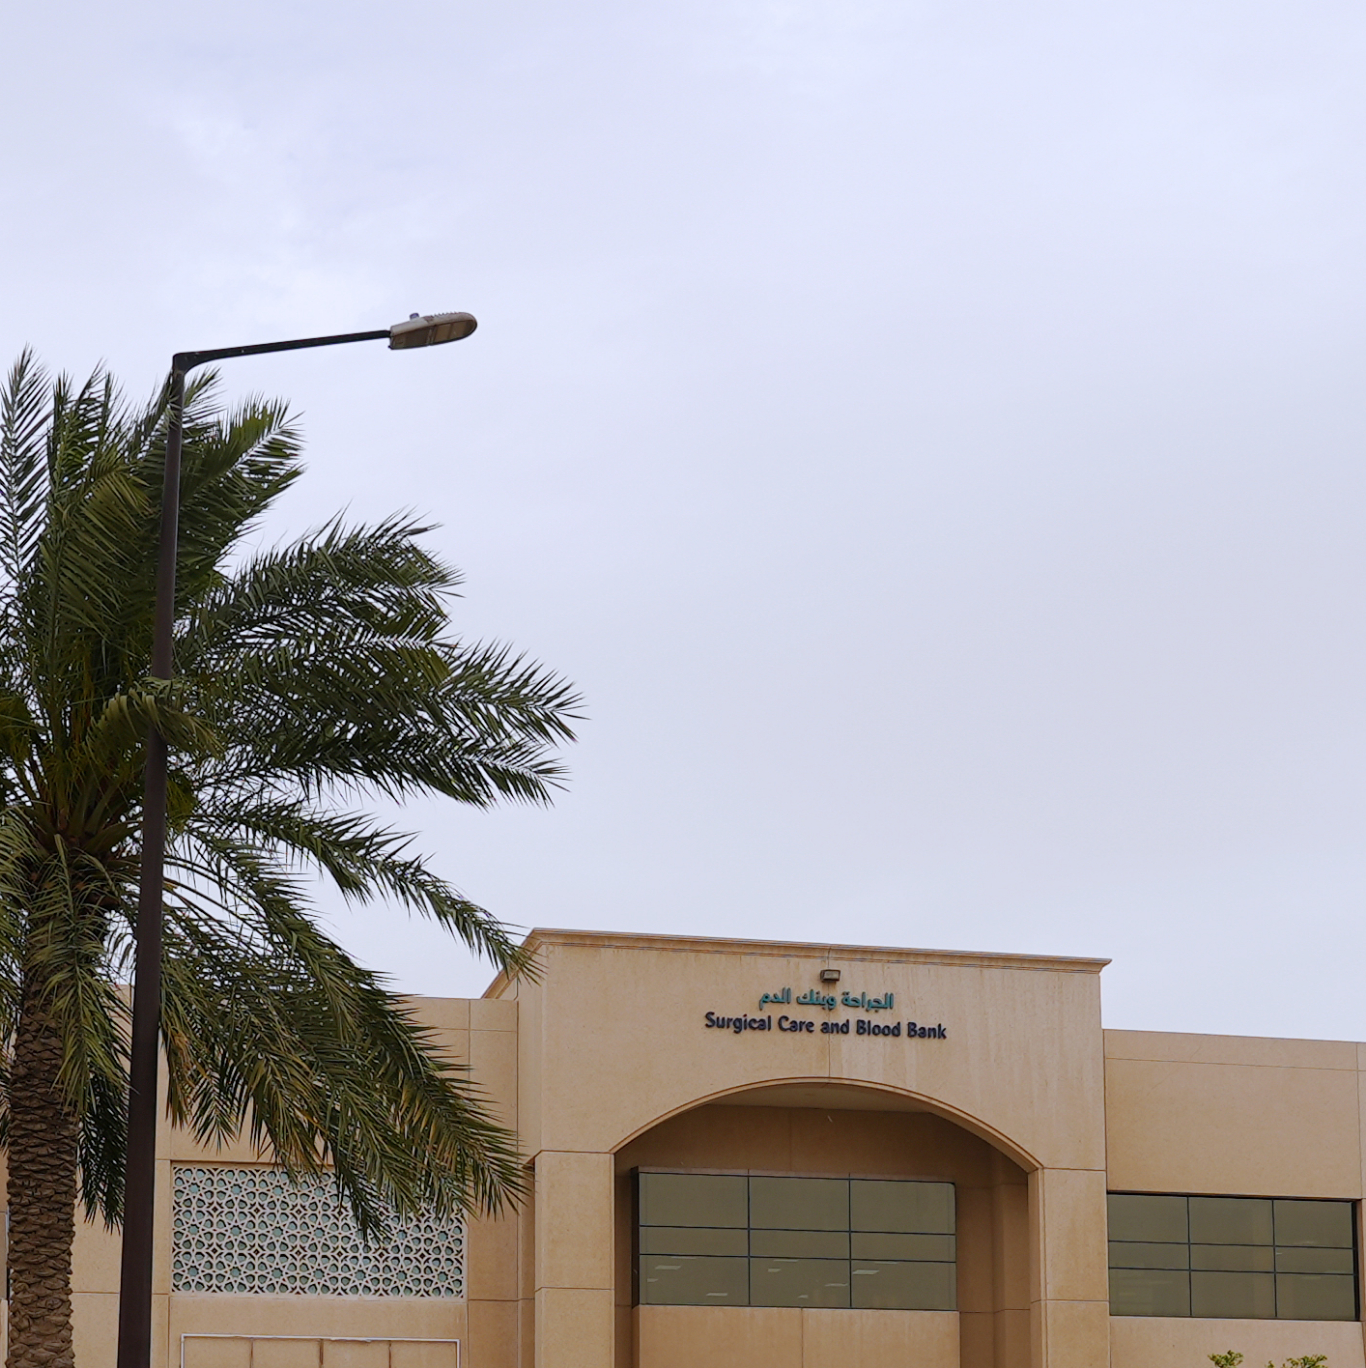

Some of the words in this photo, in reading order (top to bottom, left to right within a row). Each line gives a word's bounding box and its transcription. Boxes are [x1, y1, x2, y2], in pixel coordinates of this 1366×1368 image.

[759, 987, 792, 1011] الدم
[796, 989, 837, 1011] وبنك
[841, 991, 894, 1013] الجراحة
[705, 1011, 772, 1034] Surgical
[778, 1015, 815, 1033] Care
[820, 1019, 850, 1034] and
[856, 1019, 901, 1037] Blood
[907, 1022, 947, 1040] Bank
